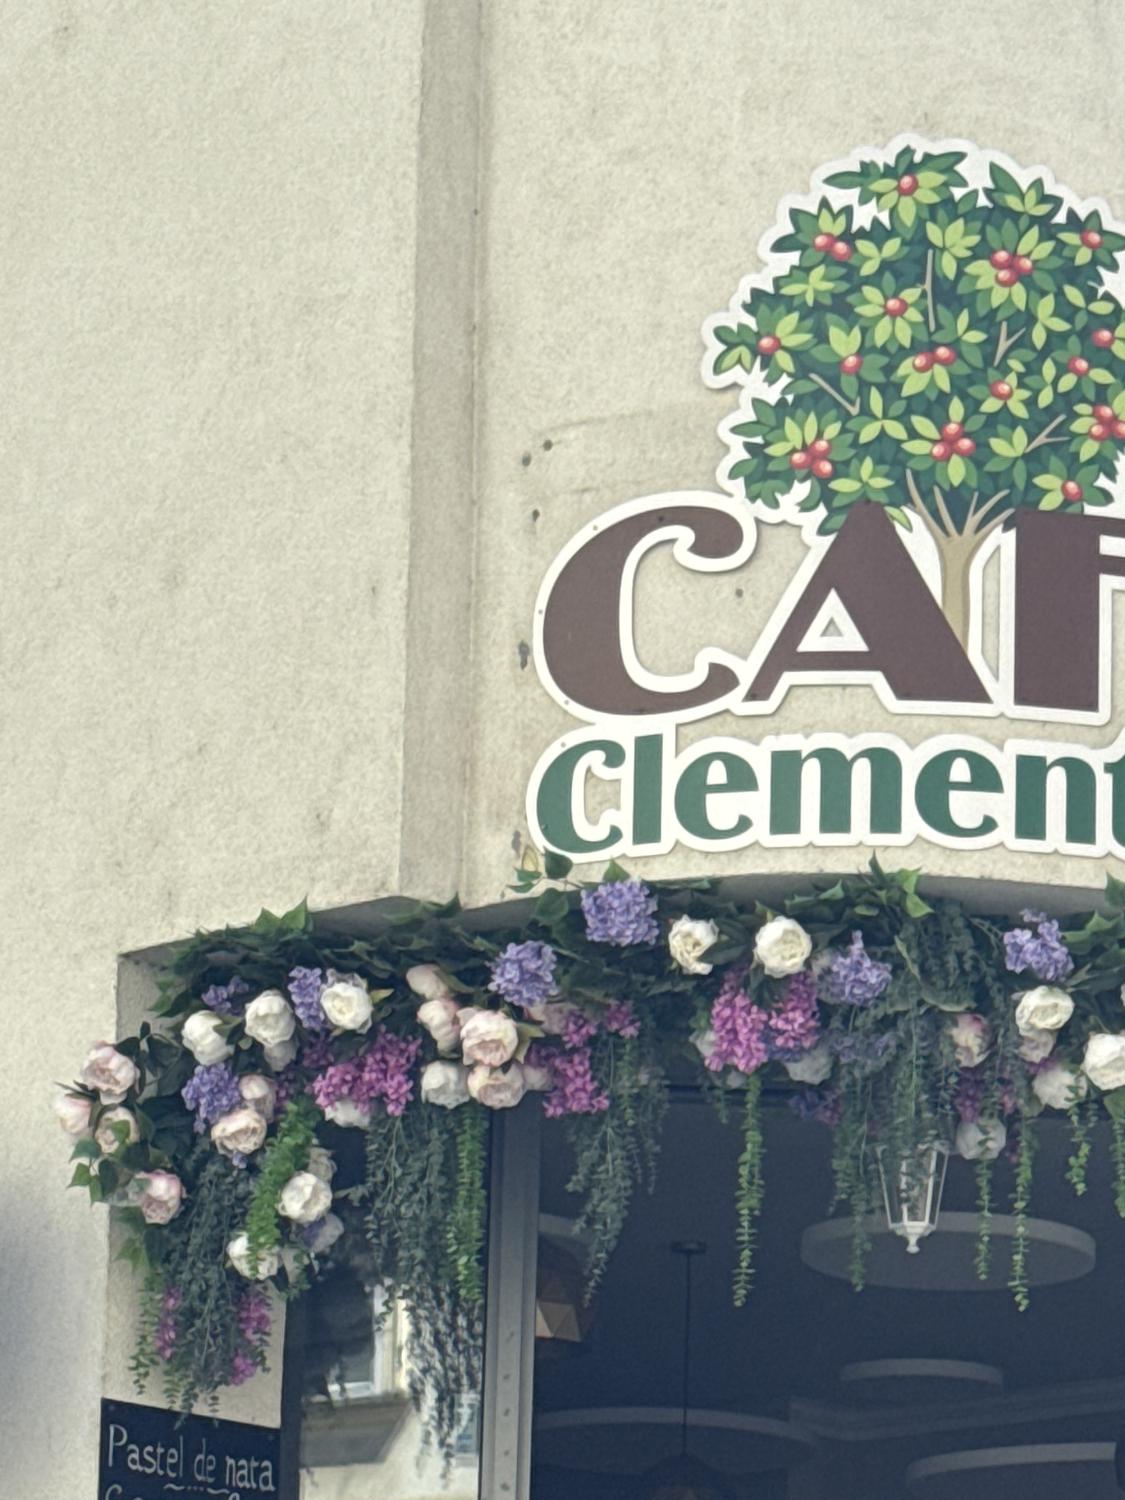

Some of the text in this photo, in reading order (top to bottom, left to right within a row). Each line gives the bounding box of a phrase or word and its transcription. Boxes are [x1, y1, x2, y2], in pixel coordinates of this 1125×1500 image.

[108, 1424, 276, 1492] Pastel de nata
